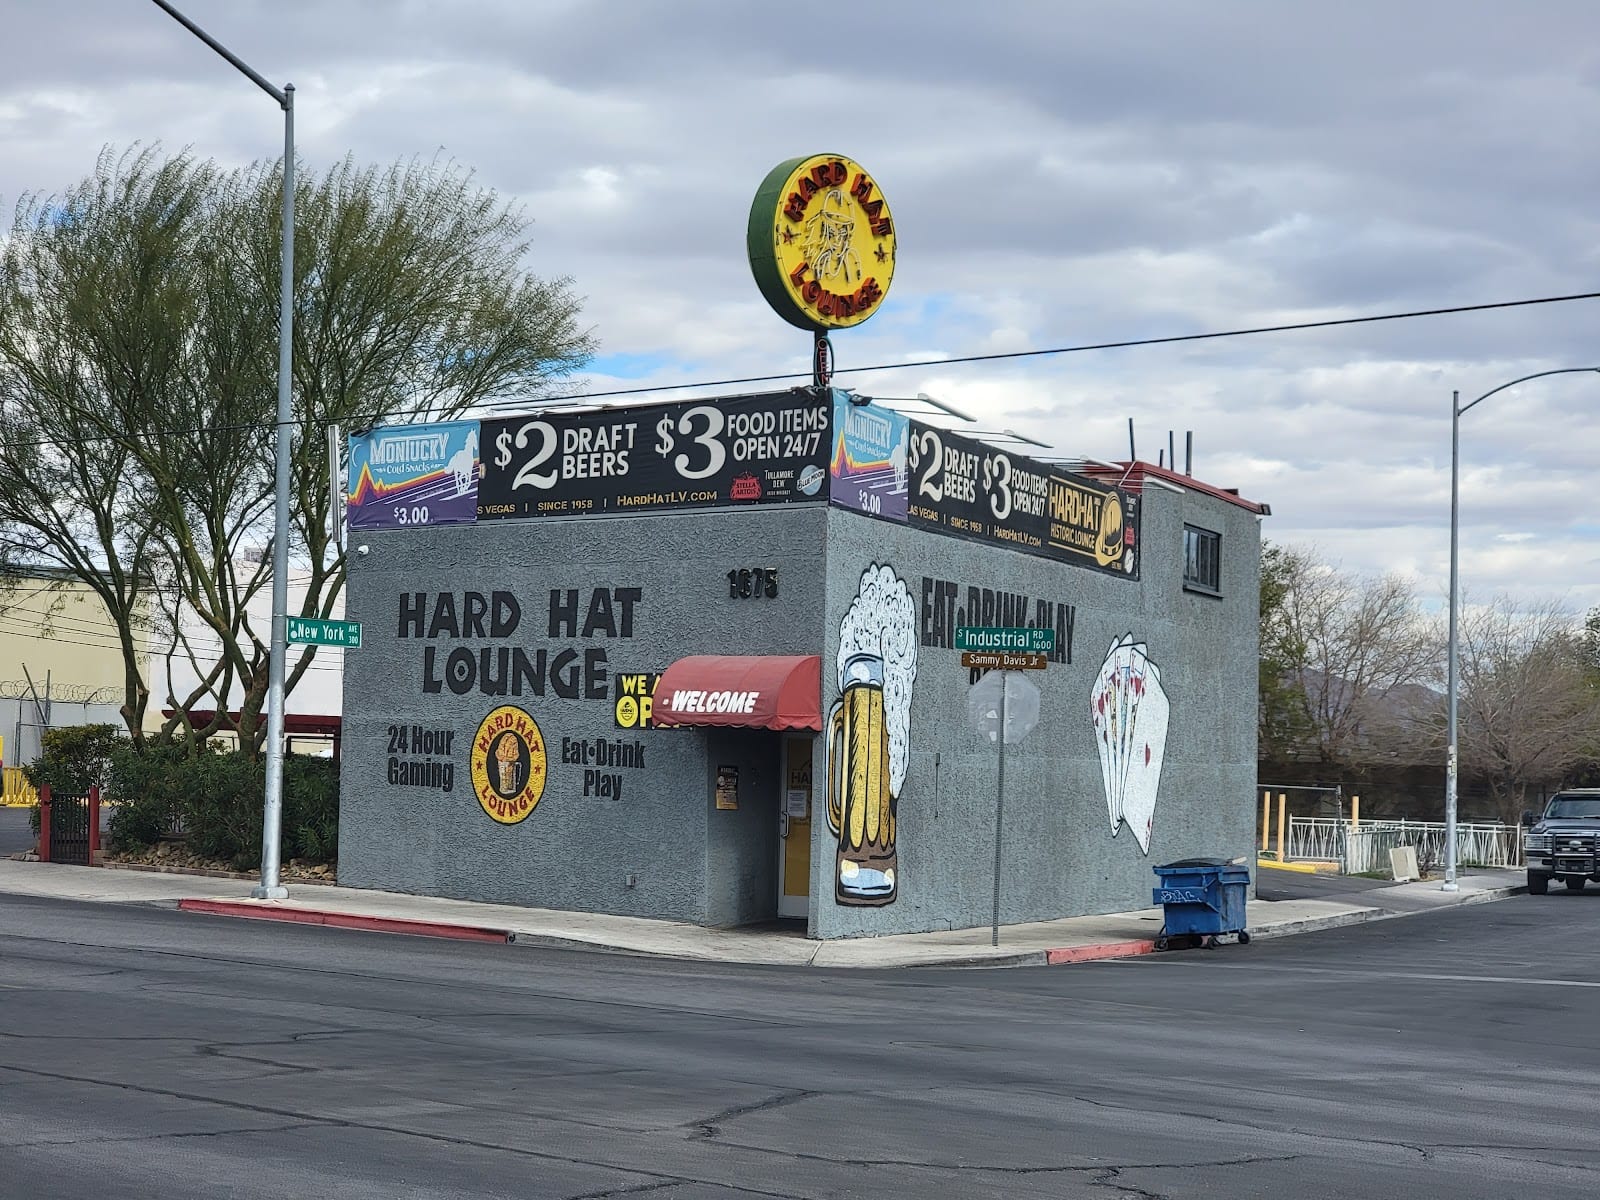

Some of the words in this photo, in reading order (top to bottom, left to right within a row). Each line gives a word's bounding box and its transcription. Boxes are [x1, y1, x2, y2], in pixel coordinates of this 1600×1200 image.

[784, 161, 848, 222] HARD
[850, 173, 892, 236] HAT
[789, 262, 883, 319] LOUNGE
[727, 411, 776, 438] FOOD
[779, 406, 828, 434] ITEMS
[370, 432, 449, 465] MONTUCKY
[563, 423, 637, 454] DRAFT
[733, 436, 780, 461] OPEN
[784, 433, 821, 459] 24/7
[562, 450, 630, 480] BEERS
[944, 446, 979, 479] DRAFT
[944, 473, 976, 504] BEERS
[1012, 468, 1030, 493] FOOD
[1031, 474, 1048, 498] ITEMS
[394, 505, 428, 524] $3.00
[485, 504, 516, 514] VEGAS
[538, 501, 567, 511] SINCE
[571, 500, 593, 510] 1958
[859, 489, 880, 514] $3.00
[1014, 491, 1031, 514] OPEN
[1032, 496, 1045, 518] 24/7
[1049, 482, 1100, 531] HARDHAT
[919, 507, 938, 521] VEGAS
[951, 517, 968, 530] SINCE
[1050, 522, 1074, 543] HISTORIC
[1075, 530, 1095, 549] LOUNGE
[727, 567, 779, 598] 1675
[397, 591, 521, 638] HARD
[548, 587, 642, 638] HAT
[298, 623, 318, 638] New
[323, 625, 344, 640] York
[348, 625, 358, 633] AVE
[348, 636, 358, 644] 300
[958, 630, 963, 638] S
[966, 630, 1029, 647] Industrial
[1033, 631, 1043, 639] RD
[1033, 641, 1051, 649] 1600
[423, 646, 609, 699] LOUNGE
[970, 654, 1000, 667] Sammy
[1003, 655, 1026, 665] Davis
[1030, 656, 1039, 665] Jr
[622, 675, 647, 695] WE
[672, 690, 760, 713] WELCOME
[387, 726, 408, 754] 24
[412, 725, 454, 755] Hour
[479, 713, 513, 753] HARD
[515, 716, 540, 753] HAT
[387, 757, 454, 792] Gaming
[584, 769, 622, 800] Play
[482, 785, 535, 817] LOUNGE
